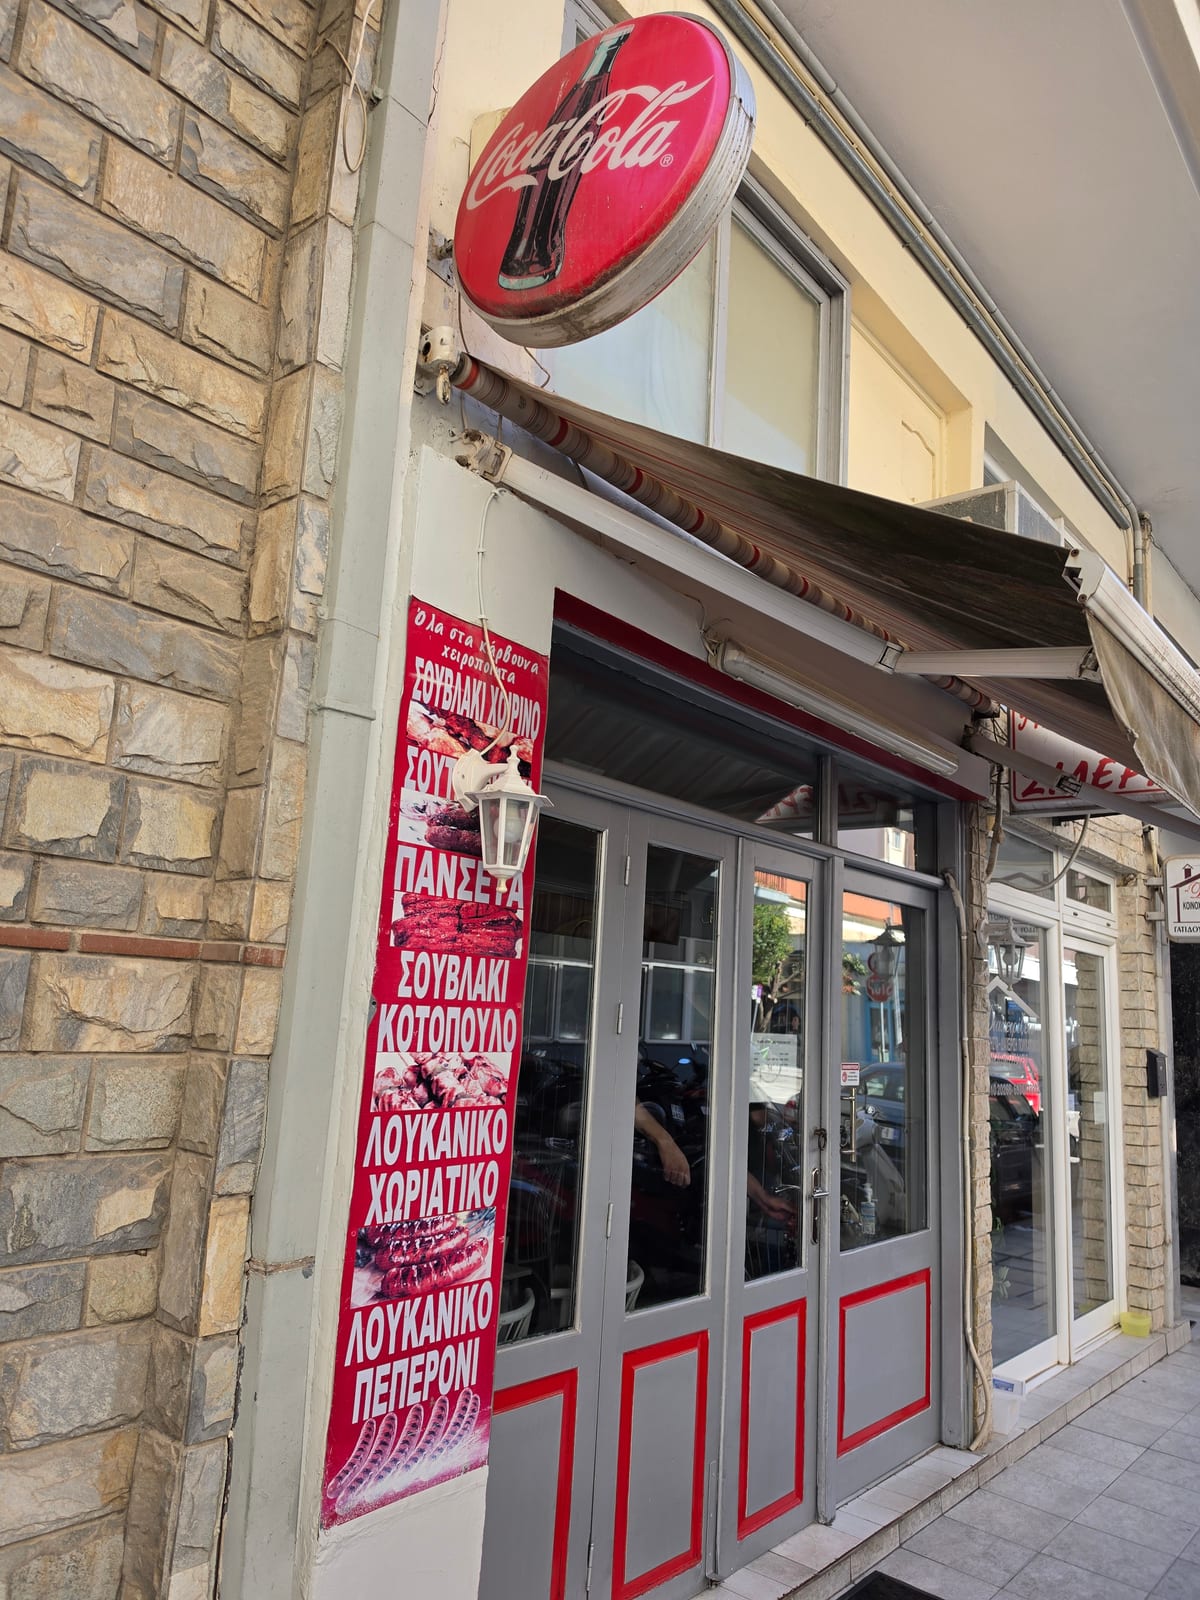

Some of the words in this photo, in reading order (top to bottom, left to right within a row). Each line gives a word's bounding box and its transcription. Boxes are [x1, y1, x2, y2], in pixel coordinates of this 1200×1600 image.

[466, 75, 714, 211] Coca-Cola
[450, 627, 473, 648] στα
[411, 656, 486, 722] ΣΟΥΒΛΑΚΙ
[397, 950, 510, 1003] ΣΟΥΒΛΑΚΙ
[376, 1003, 517, 1053] ΚΟΤΟΠΟΥΛΟ
[362, 1108, 508, 1168] ΛΟΥΚΑΝΙΚΟ
[364, 1160, 499, 1227] ΧΩΡΙΑΤΙΚΟ
[344, 1280, 494, 1368] ΛΟΥΚΑΝΙΚΟ
[352, 1337, 481, 1425] ΠΕΠΕΡΟΝΙ
